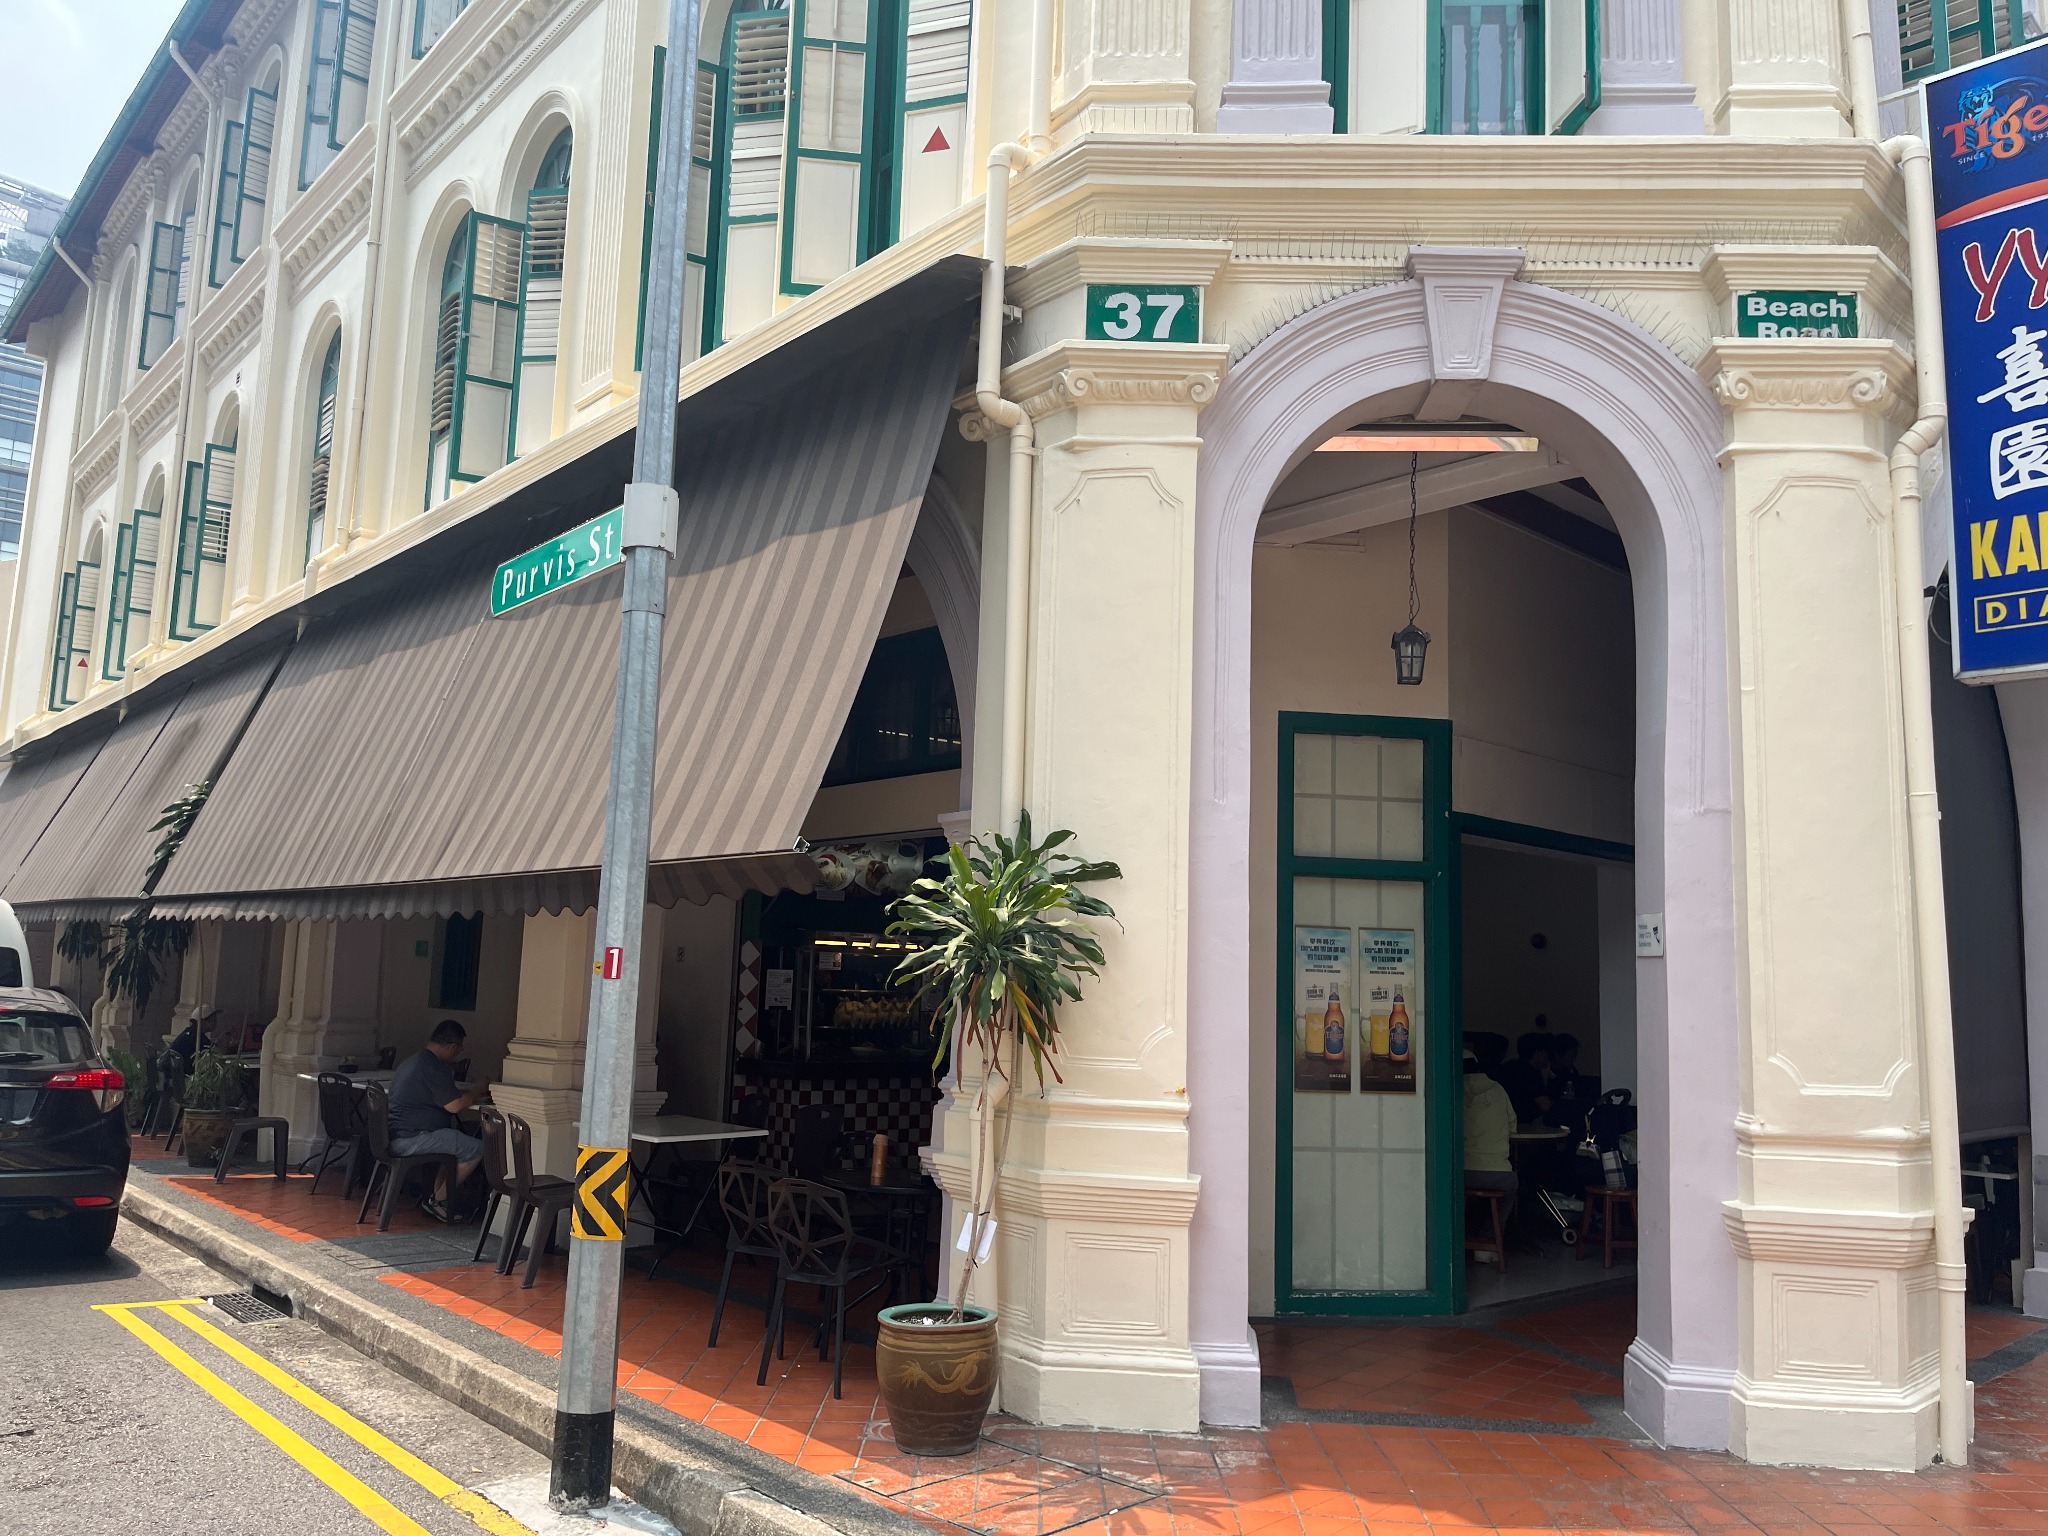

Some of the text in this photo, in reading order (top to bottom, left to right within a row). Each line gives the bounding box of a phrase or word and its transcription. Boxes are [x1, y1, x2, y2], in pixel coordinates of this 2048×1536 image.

[1957, 152, 1986, 166] SINCE
[1102, 292, 1185, 340] 37
[1747, 297, 1848, 318] Beach
[501, 522, 614, 605] Purvis St
[609, 948, 620, 979] 1
